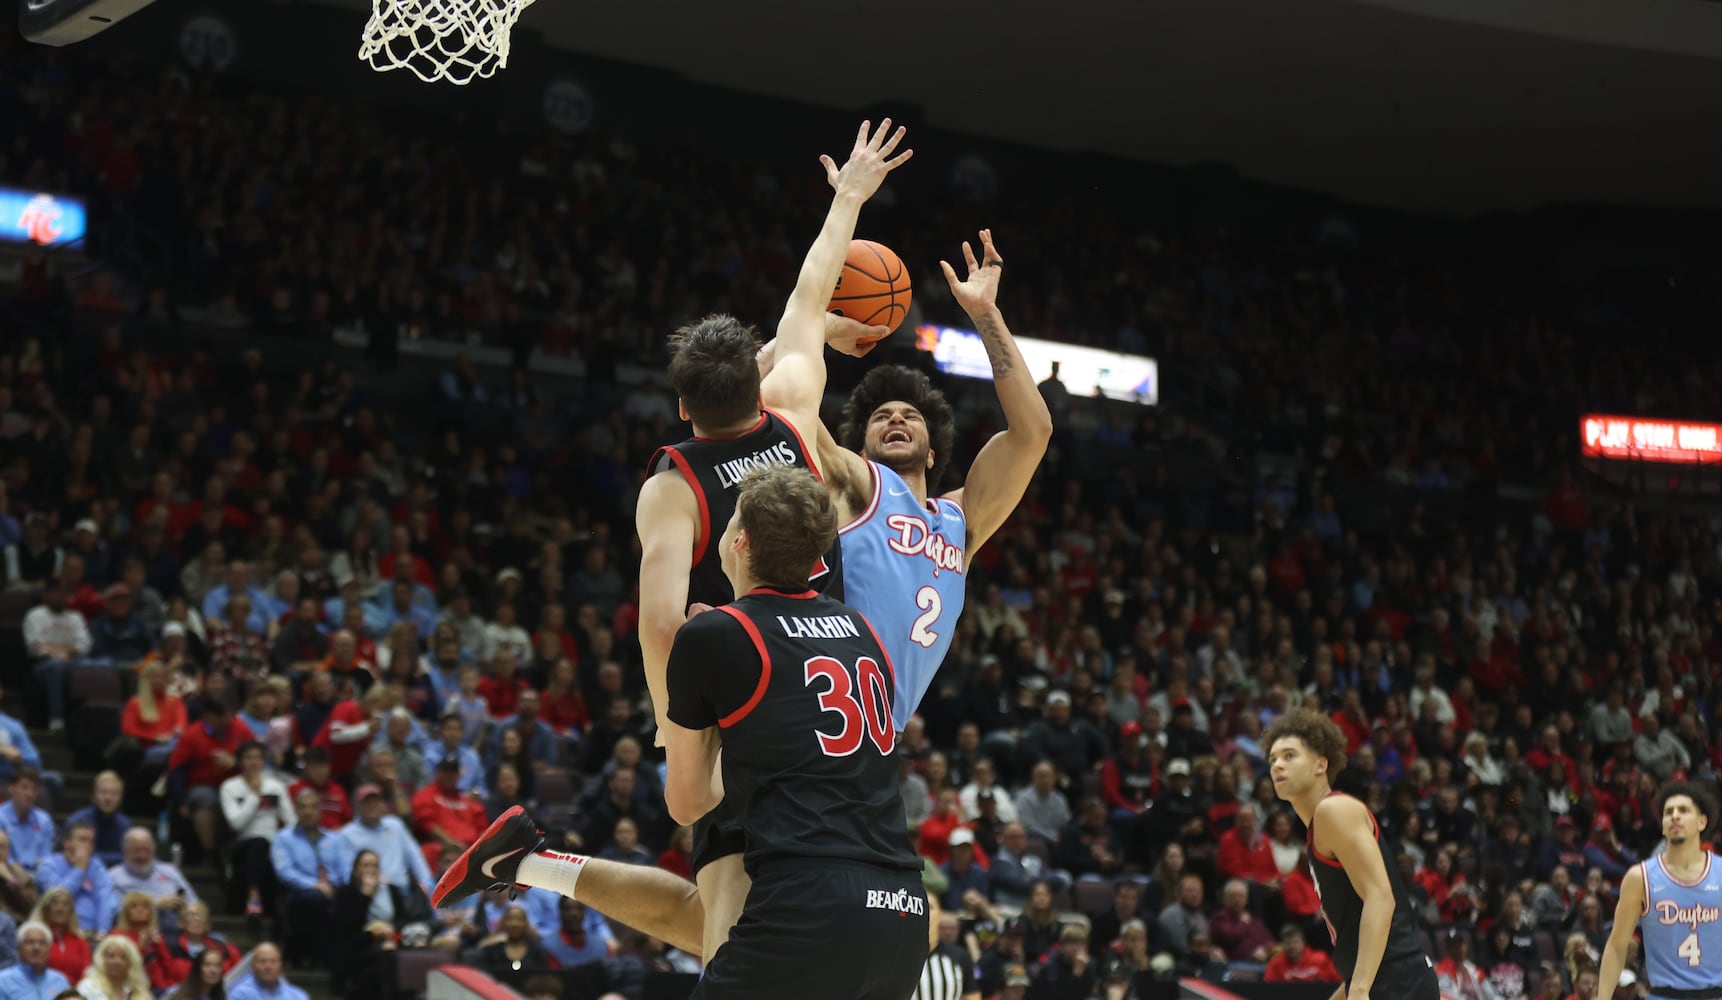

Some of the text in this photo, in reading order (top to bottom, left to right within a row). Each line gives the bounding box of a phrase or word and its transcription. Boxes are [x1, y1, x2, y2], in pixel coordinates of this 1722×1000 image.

[776, 615, 860, 638] LAKHIN
[909, 585, 942, 648] 2
[804, 656, 896, 757] 30
[865, 889, 924, 916] BEARCATS
[1655, 900, 1719, 930] Dayton
[1678, 932, 1701, 967] 4
